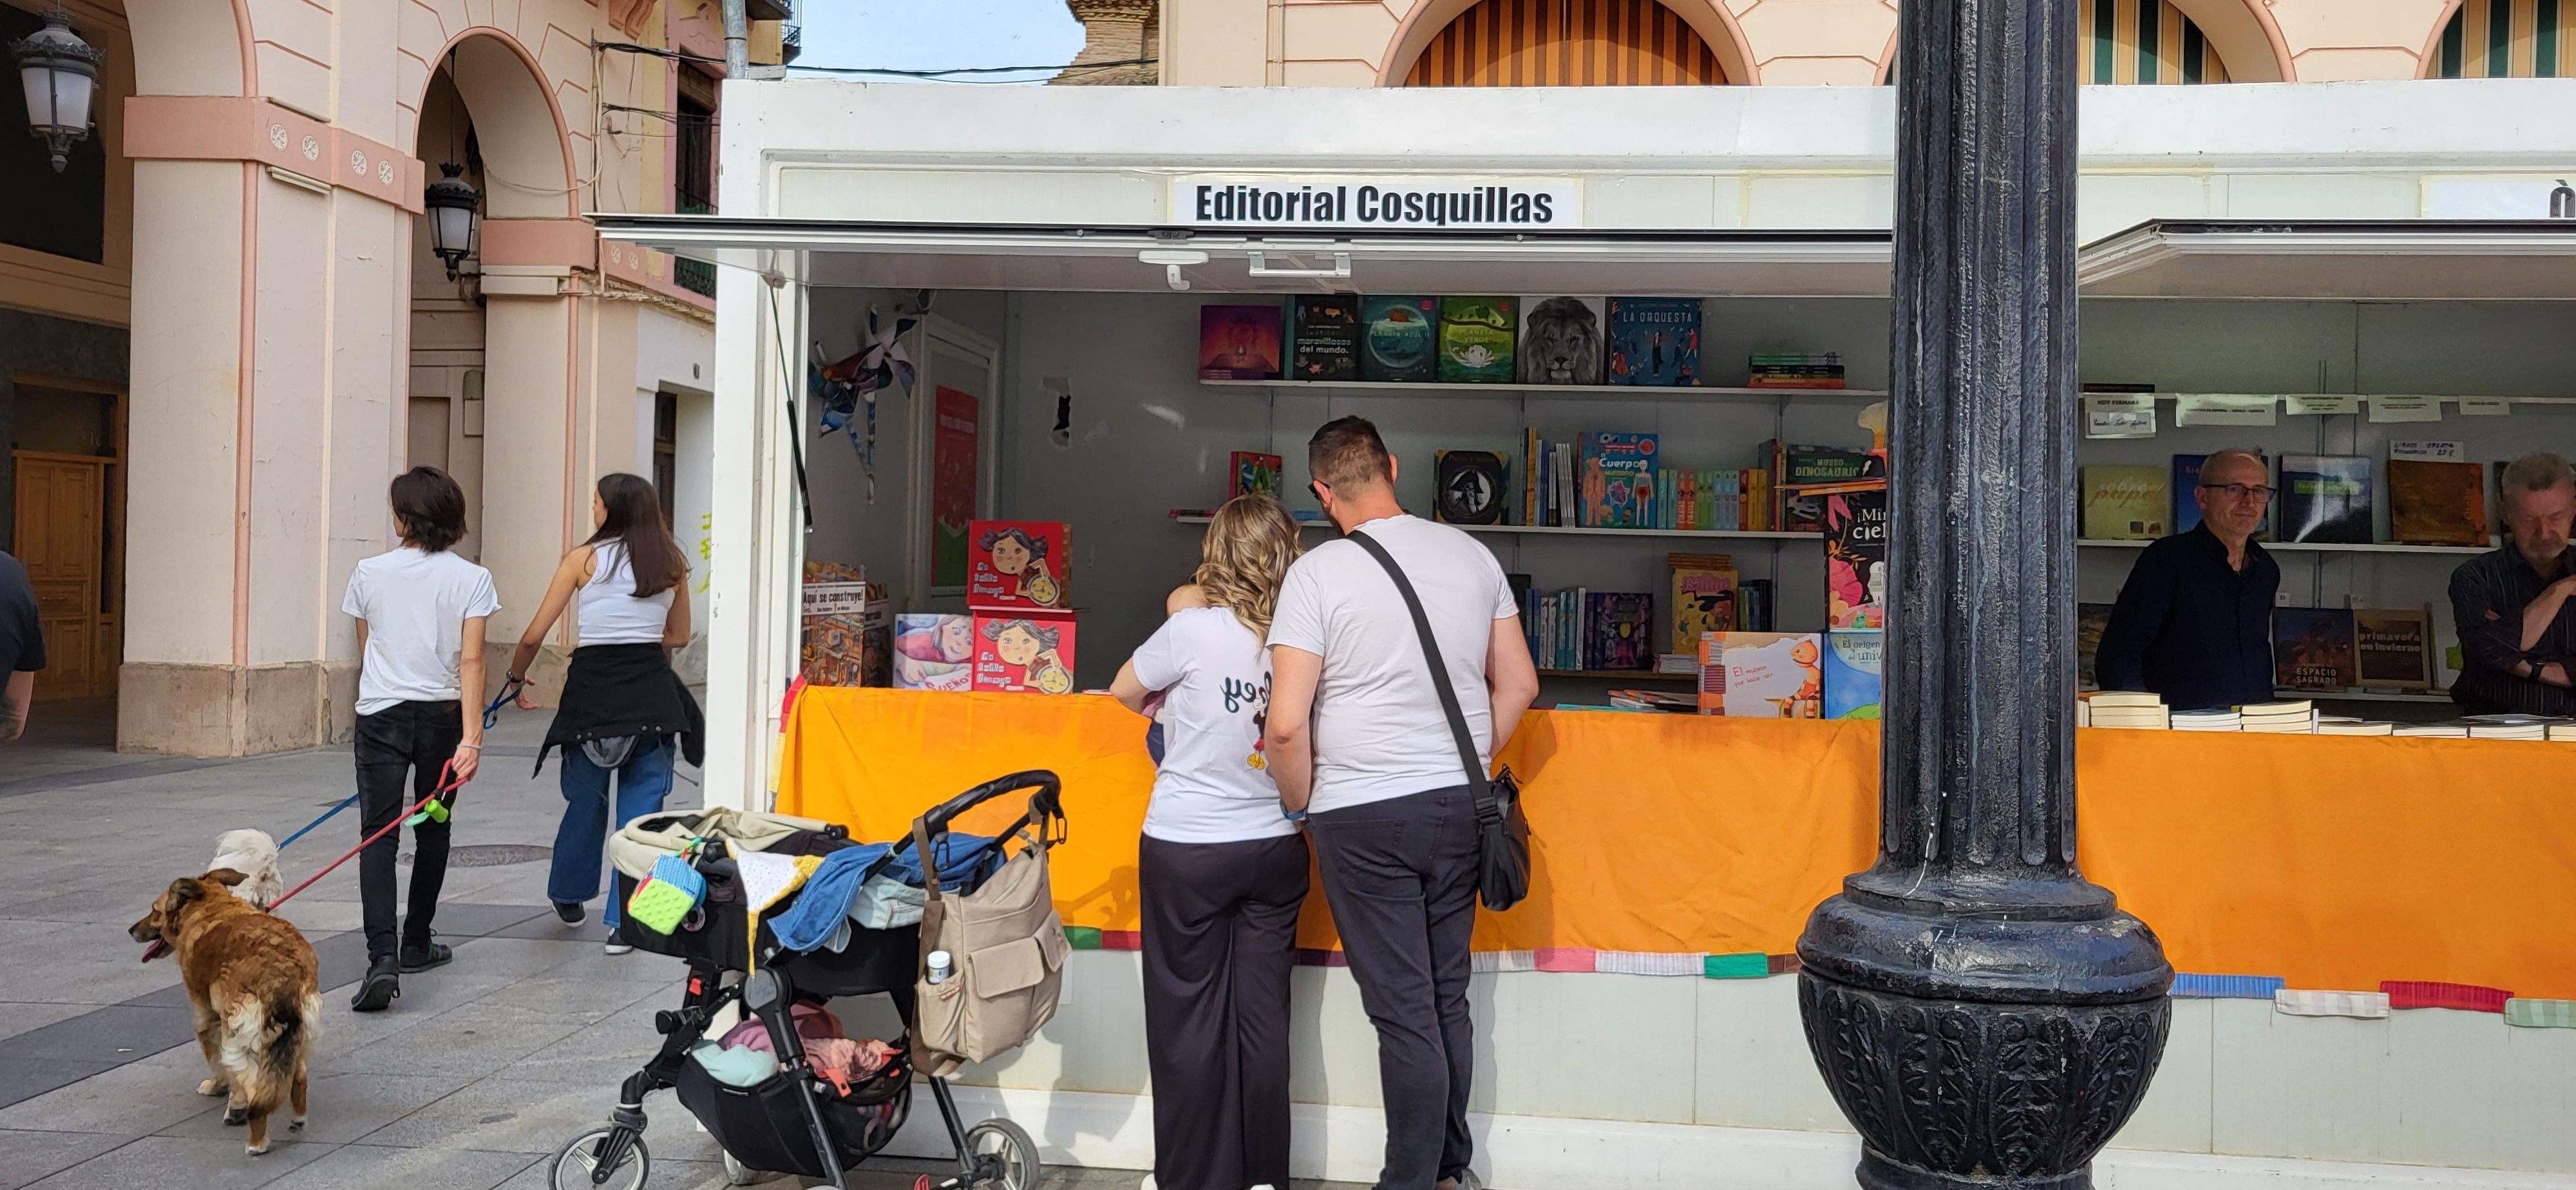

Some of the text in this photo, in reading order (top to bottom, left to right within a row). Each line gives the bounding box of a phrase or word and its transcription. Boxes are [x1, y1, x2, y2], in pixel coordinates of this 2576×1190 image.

[1196, 185, 1553, 226] Editorial Cosquillas
[1623, 312, 1692, 323] LA ORQUESTA
[1598, 457, 1640, 470] Cuerpo
[1817, 458, 1844, 466] MUSEO
[1852, 522, 1886, 542] ciel
[803, 589, 864, 606] Aquí se construye!
[2359, 632, 2420, 642] primavera
[1842, 639, 1880, 650] El origen
[2374, 643, 2421, 652] invierno
[1857, 650, 1882, 661] univ
[1732, 666, 1743, 677] El
[2297, 667, 2337, 676] ESPACIO
[2297, 676, 2337, 685] SAGRADO
